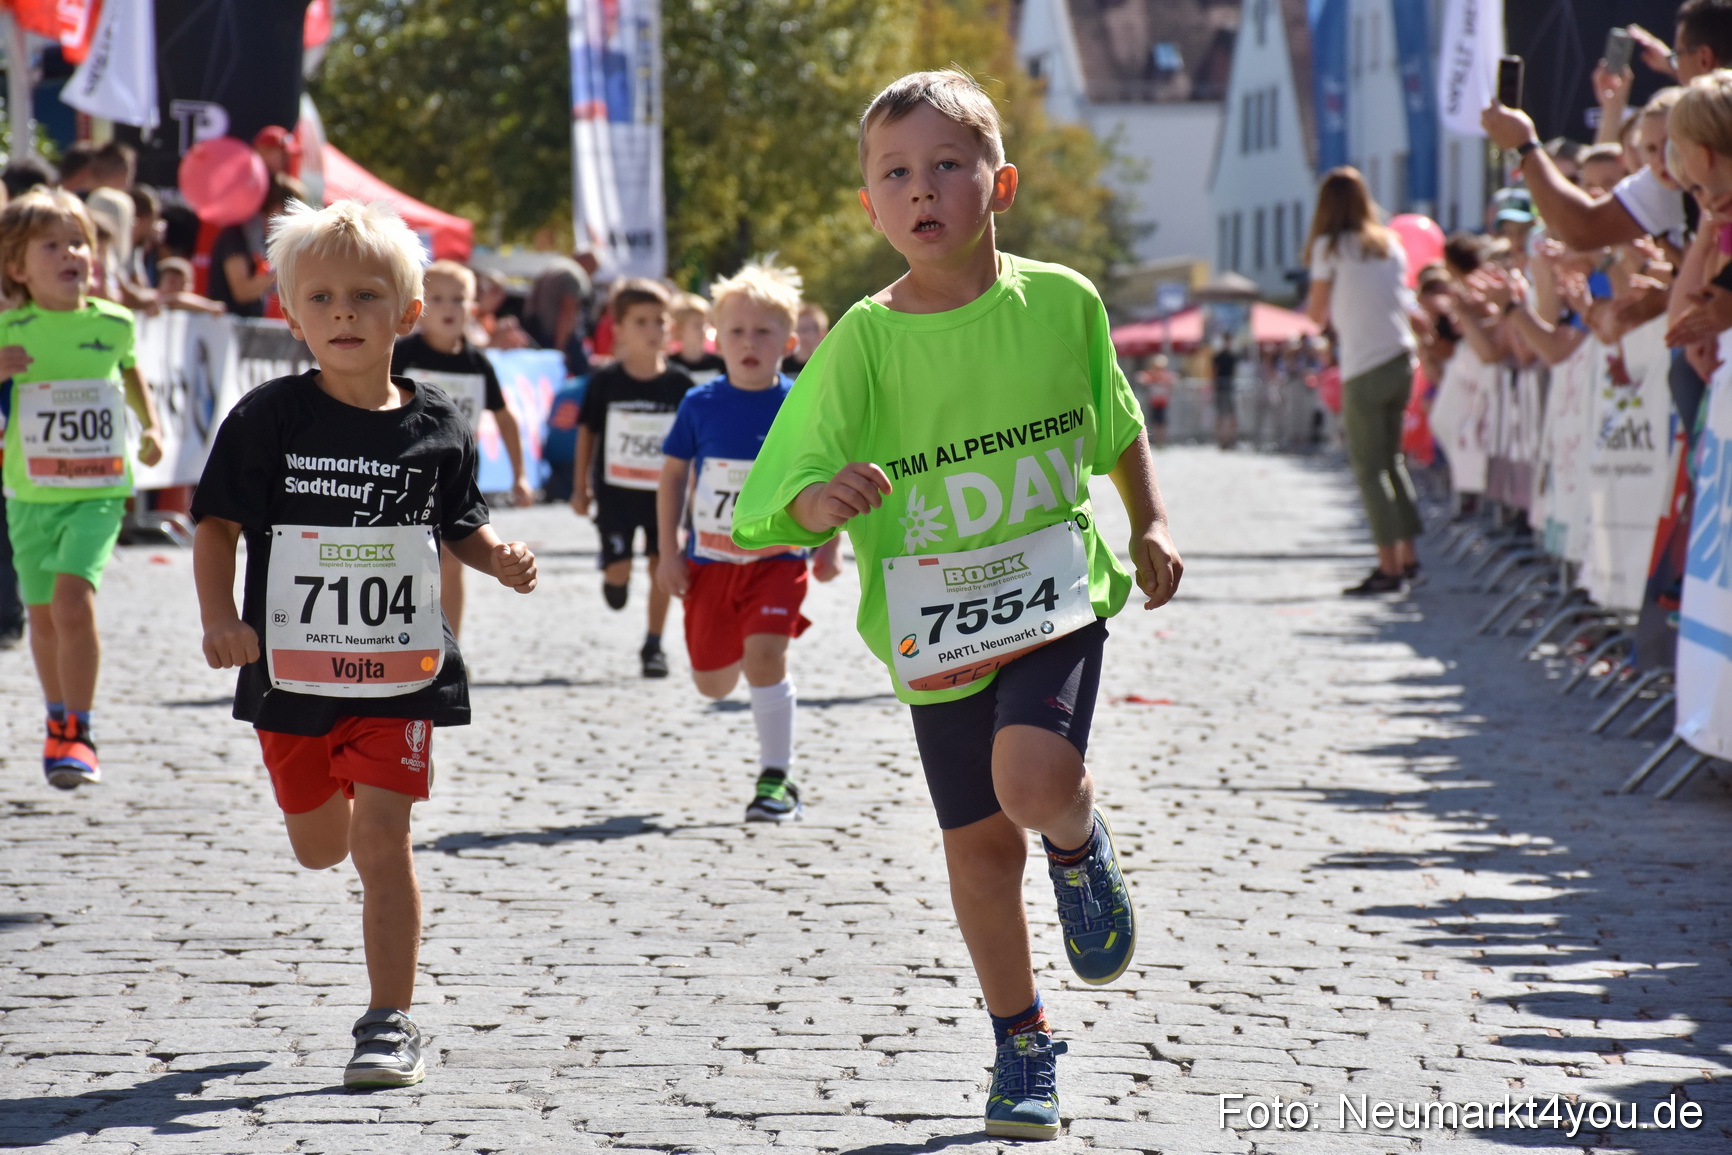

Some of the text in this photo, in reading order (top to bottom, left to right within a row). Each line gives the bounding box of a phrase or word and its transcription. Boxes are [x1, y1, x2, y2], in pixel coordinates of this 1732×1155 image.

[36, 408, 113, 443] 7508
[936, 407, 1084, 467] ALPENVEREIN
[618, 432, 662, 459] 756
[285, 453, 400, 478] Neumarkter
[284, 476, 374, 504] Sadtlauf
[944, 436, 1084, 538] DAV
[319, 544, 395, 561] BOCK
[943, 552, 1029, 586] BOCK
[946, 570, 1032, 593] inspired by smart concepts
[294, 575, 416, 627] 7104
[921, 577, 1059, 645] 7554
[274, 613, 287, 623] B2
[306, 633, 395, 645] PARTL Neumarkt
[938, 627, 1037, 664] PARTL Neumarkt
[331, 656, 385, 683] Vojta
